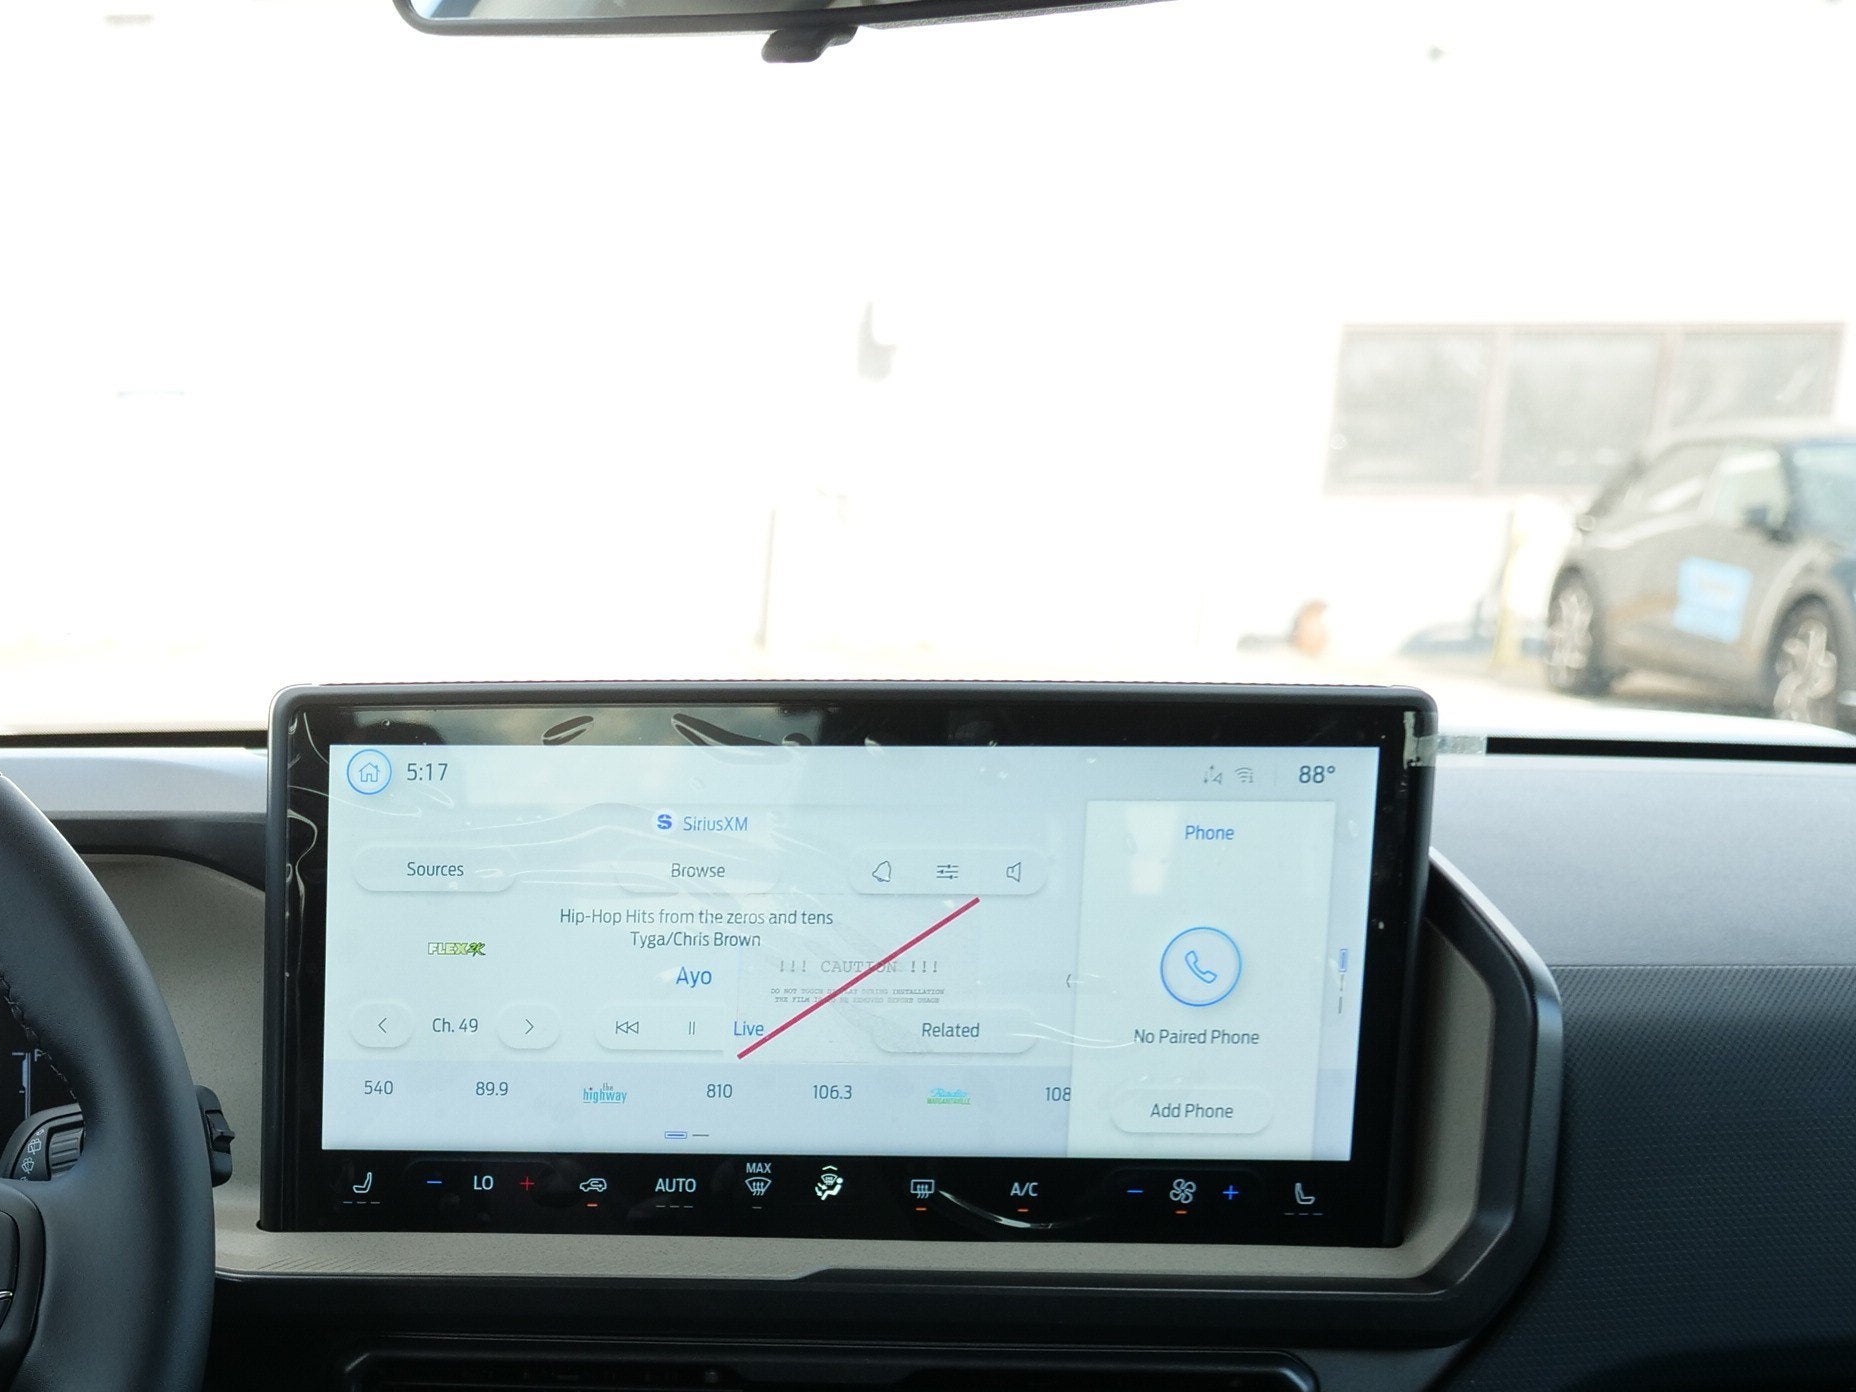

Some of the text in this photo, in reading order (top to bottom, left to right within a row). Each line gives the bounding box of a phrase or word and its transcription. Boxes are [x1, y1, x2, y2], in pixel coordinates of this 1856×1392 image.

[406, 762, 449, 782] 5:17
[1299, 765, 1336, 784] 88°
[683, 816, 749, 832] SiriusXM
[1184, 824, 1235, 841] Phone
[406, 861, 464, 878] Sources
[670, 862, 726, 879] Browse
[559, 907, 834, 928] Hip-Hop Hits from the zeros and tens
[630, 930, 761, 950] Tyga/Chris Brown
[675, 966, 713, 988] Ayo
[432, 1018, 479, 1034] Ch. 49
[733, 1021, 765, 1037] Live
[921, 1022, 980, 1038] Related
[1133, 1029, 1260, 1046] No Paired Phone
[363, 1080, 394, 1096] 540
[475, 1081, 508, 1097] 89.9
[583, 1088, 627, 1104] highway
[706, 1083, 733, 1099] 810
[812, 1084, 853, 1100] 106.3
[1150, 1103, 1234, 1120] Add Phone
[746, 1163, 772, 1175] MAX
[474, 1176, 494, 1191] LO
[655, 1178, 697, 1193] AUTO
[1010, 1181, 1038, 1197] A/C
